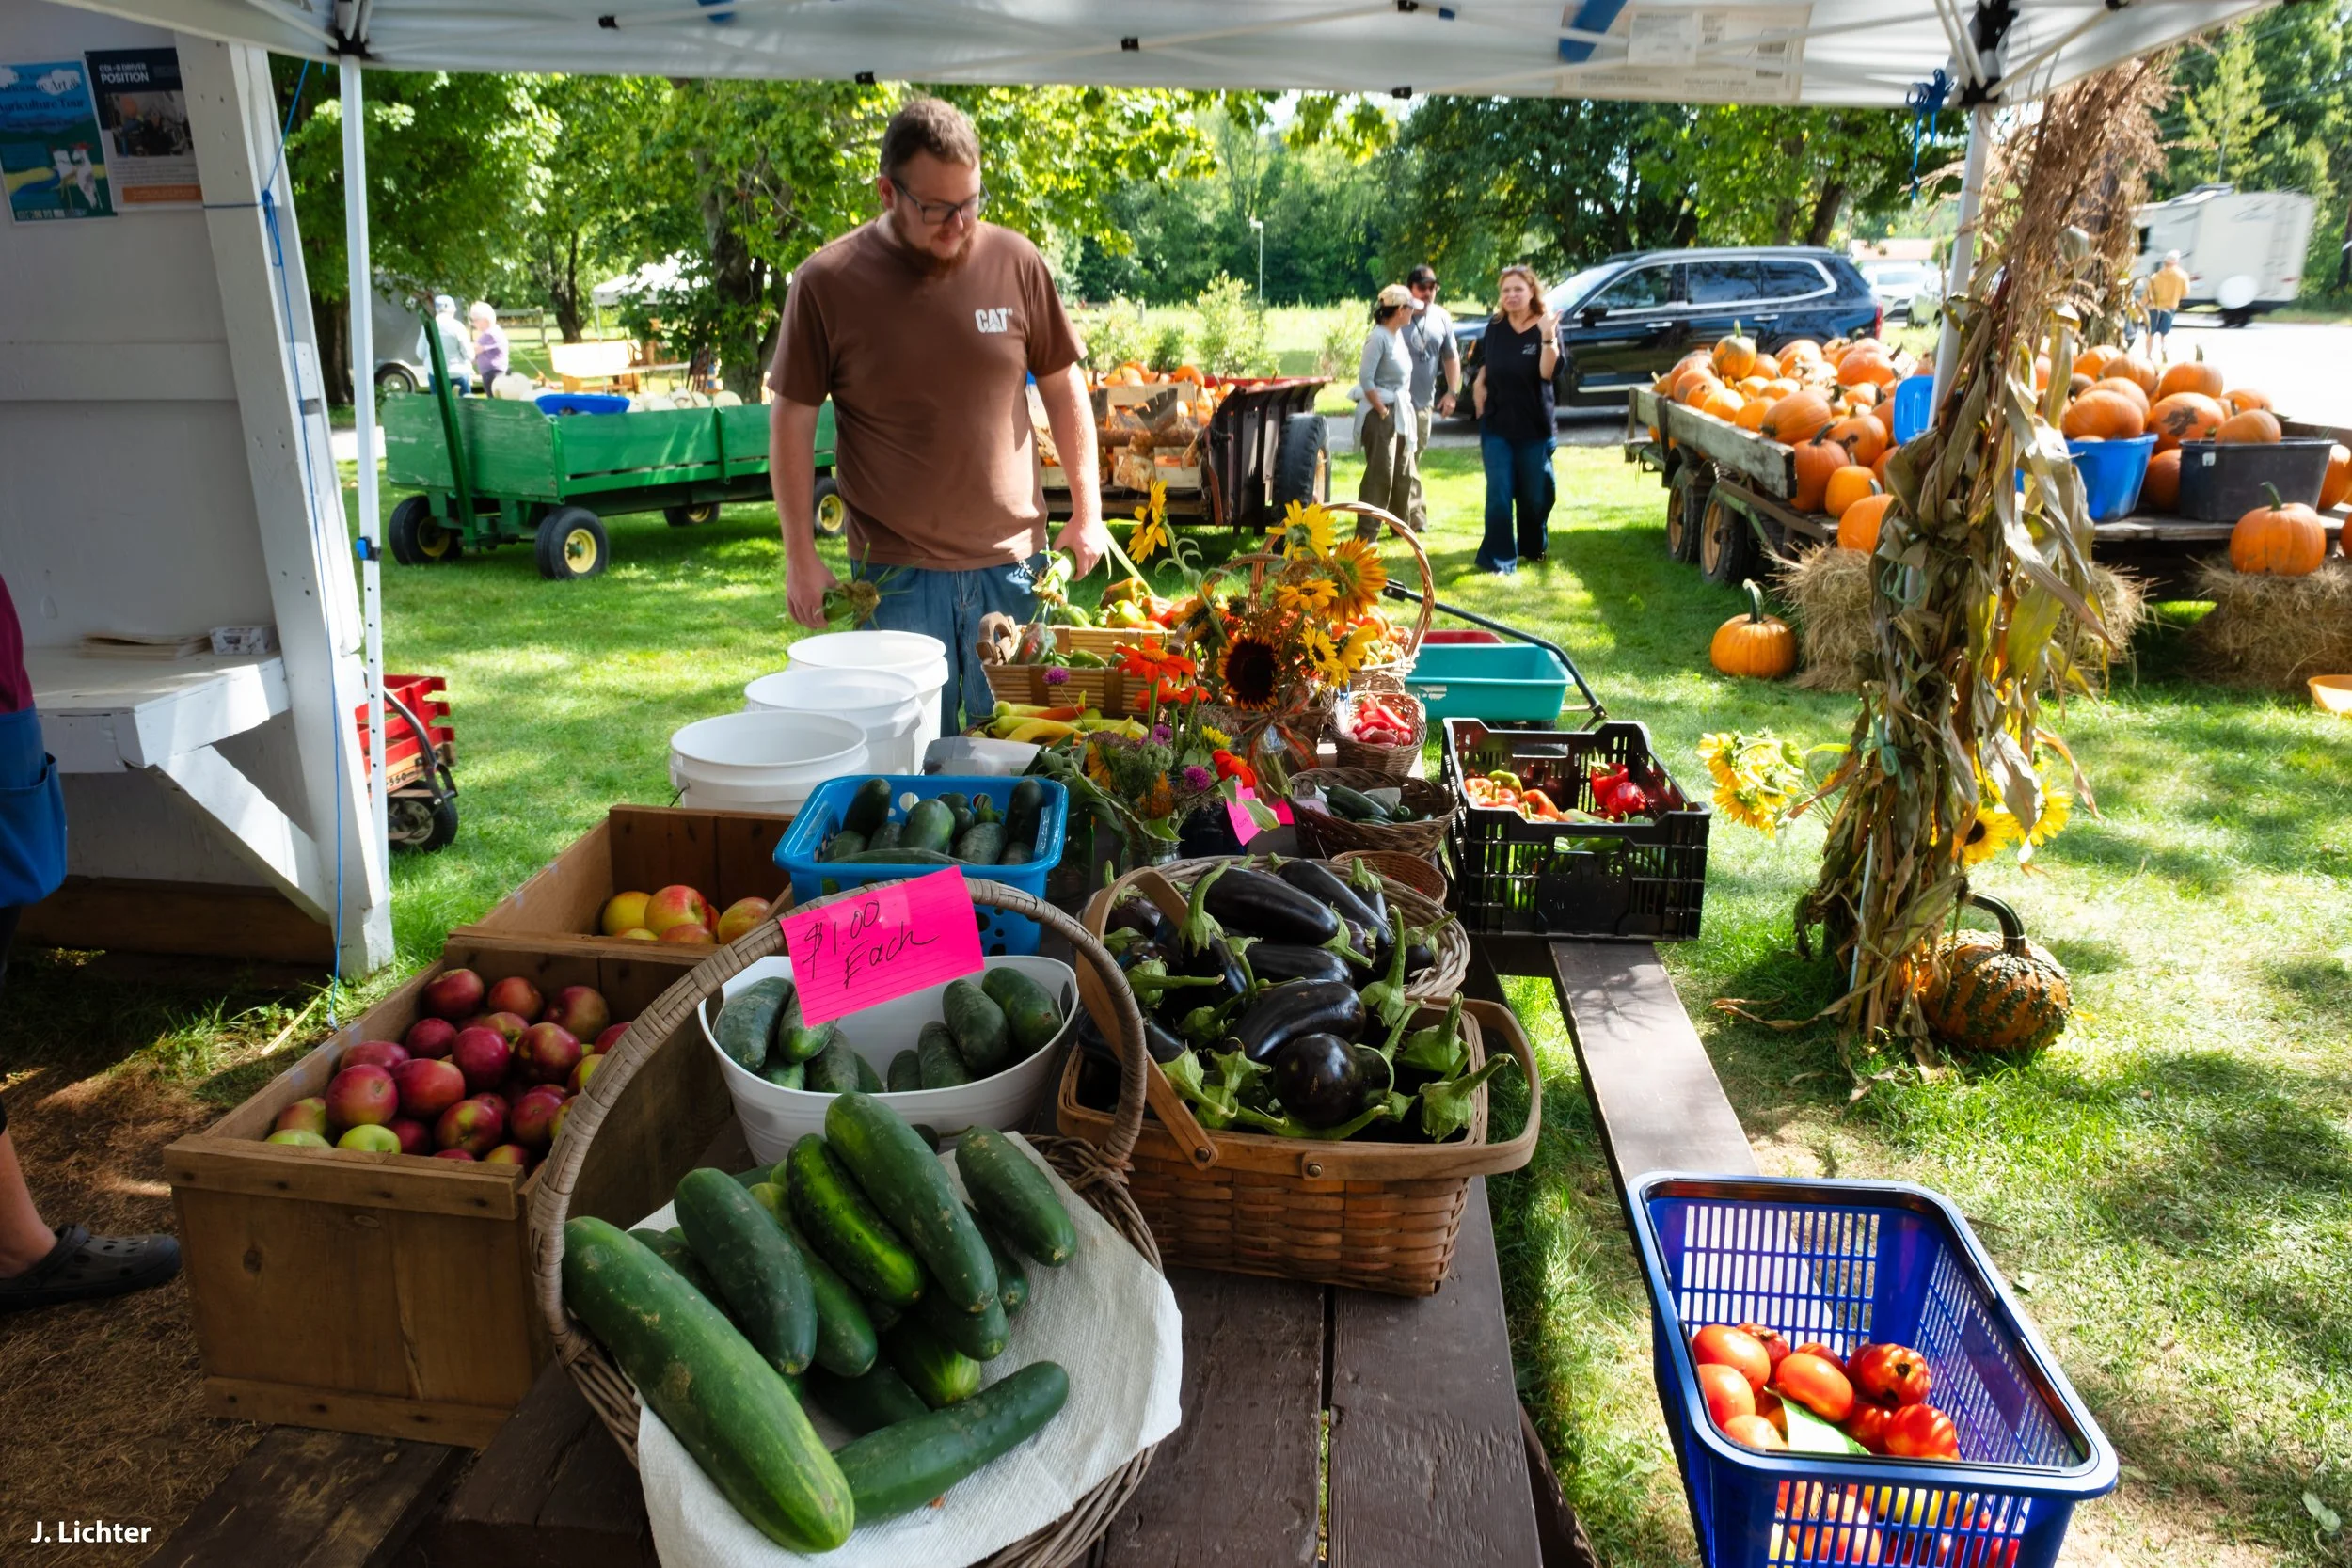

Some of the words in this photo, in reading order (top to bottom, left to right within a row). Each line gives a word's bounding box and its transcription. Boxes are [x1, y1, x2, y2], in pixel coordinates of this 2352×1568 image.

[121, 62, 147, 71] DRIVER
[51, 78, 68, 90] Art
[70, 75, 81, 90] &
[101, 71, 150, 85] POSITION
[56, 97, 84, 109] Tour
[975, 308, 1007, 333] CAT
[802, 900, 880, 980] $1.00
[844, 920, 940, 989] Each
